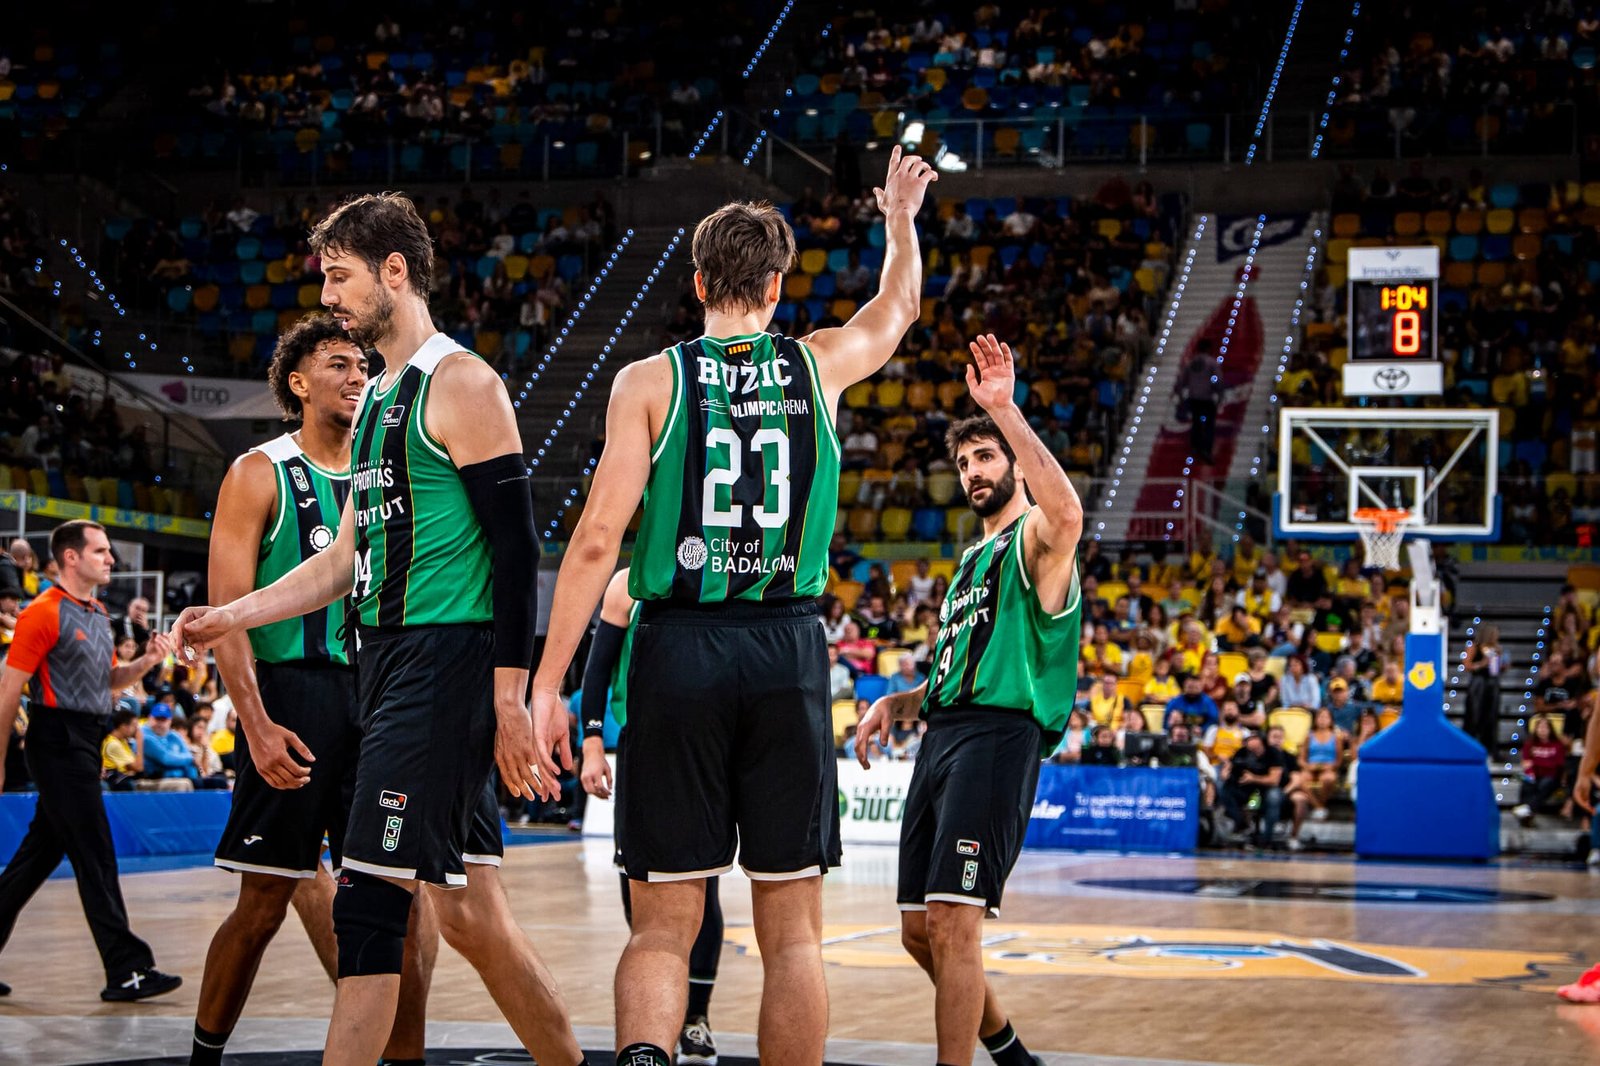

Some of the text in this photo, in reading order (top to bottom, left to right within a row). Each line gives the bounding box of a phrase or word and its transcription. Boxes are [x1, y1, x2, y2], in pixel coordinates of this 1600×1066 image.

[1381, 285, 1428, 310] 1:04
[1394, 311, 1420, 355] 8
[697, 353, 792, 395] RUŽIĆ
[730, 399, 809, 418] OLIMPICARENA
[702, 427, 790, 528] 23
[710, 538, 760, 556] City of
[711, 554, 795, 574] BADALONA
[382, 798, 400, 807] acb
